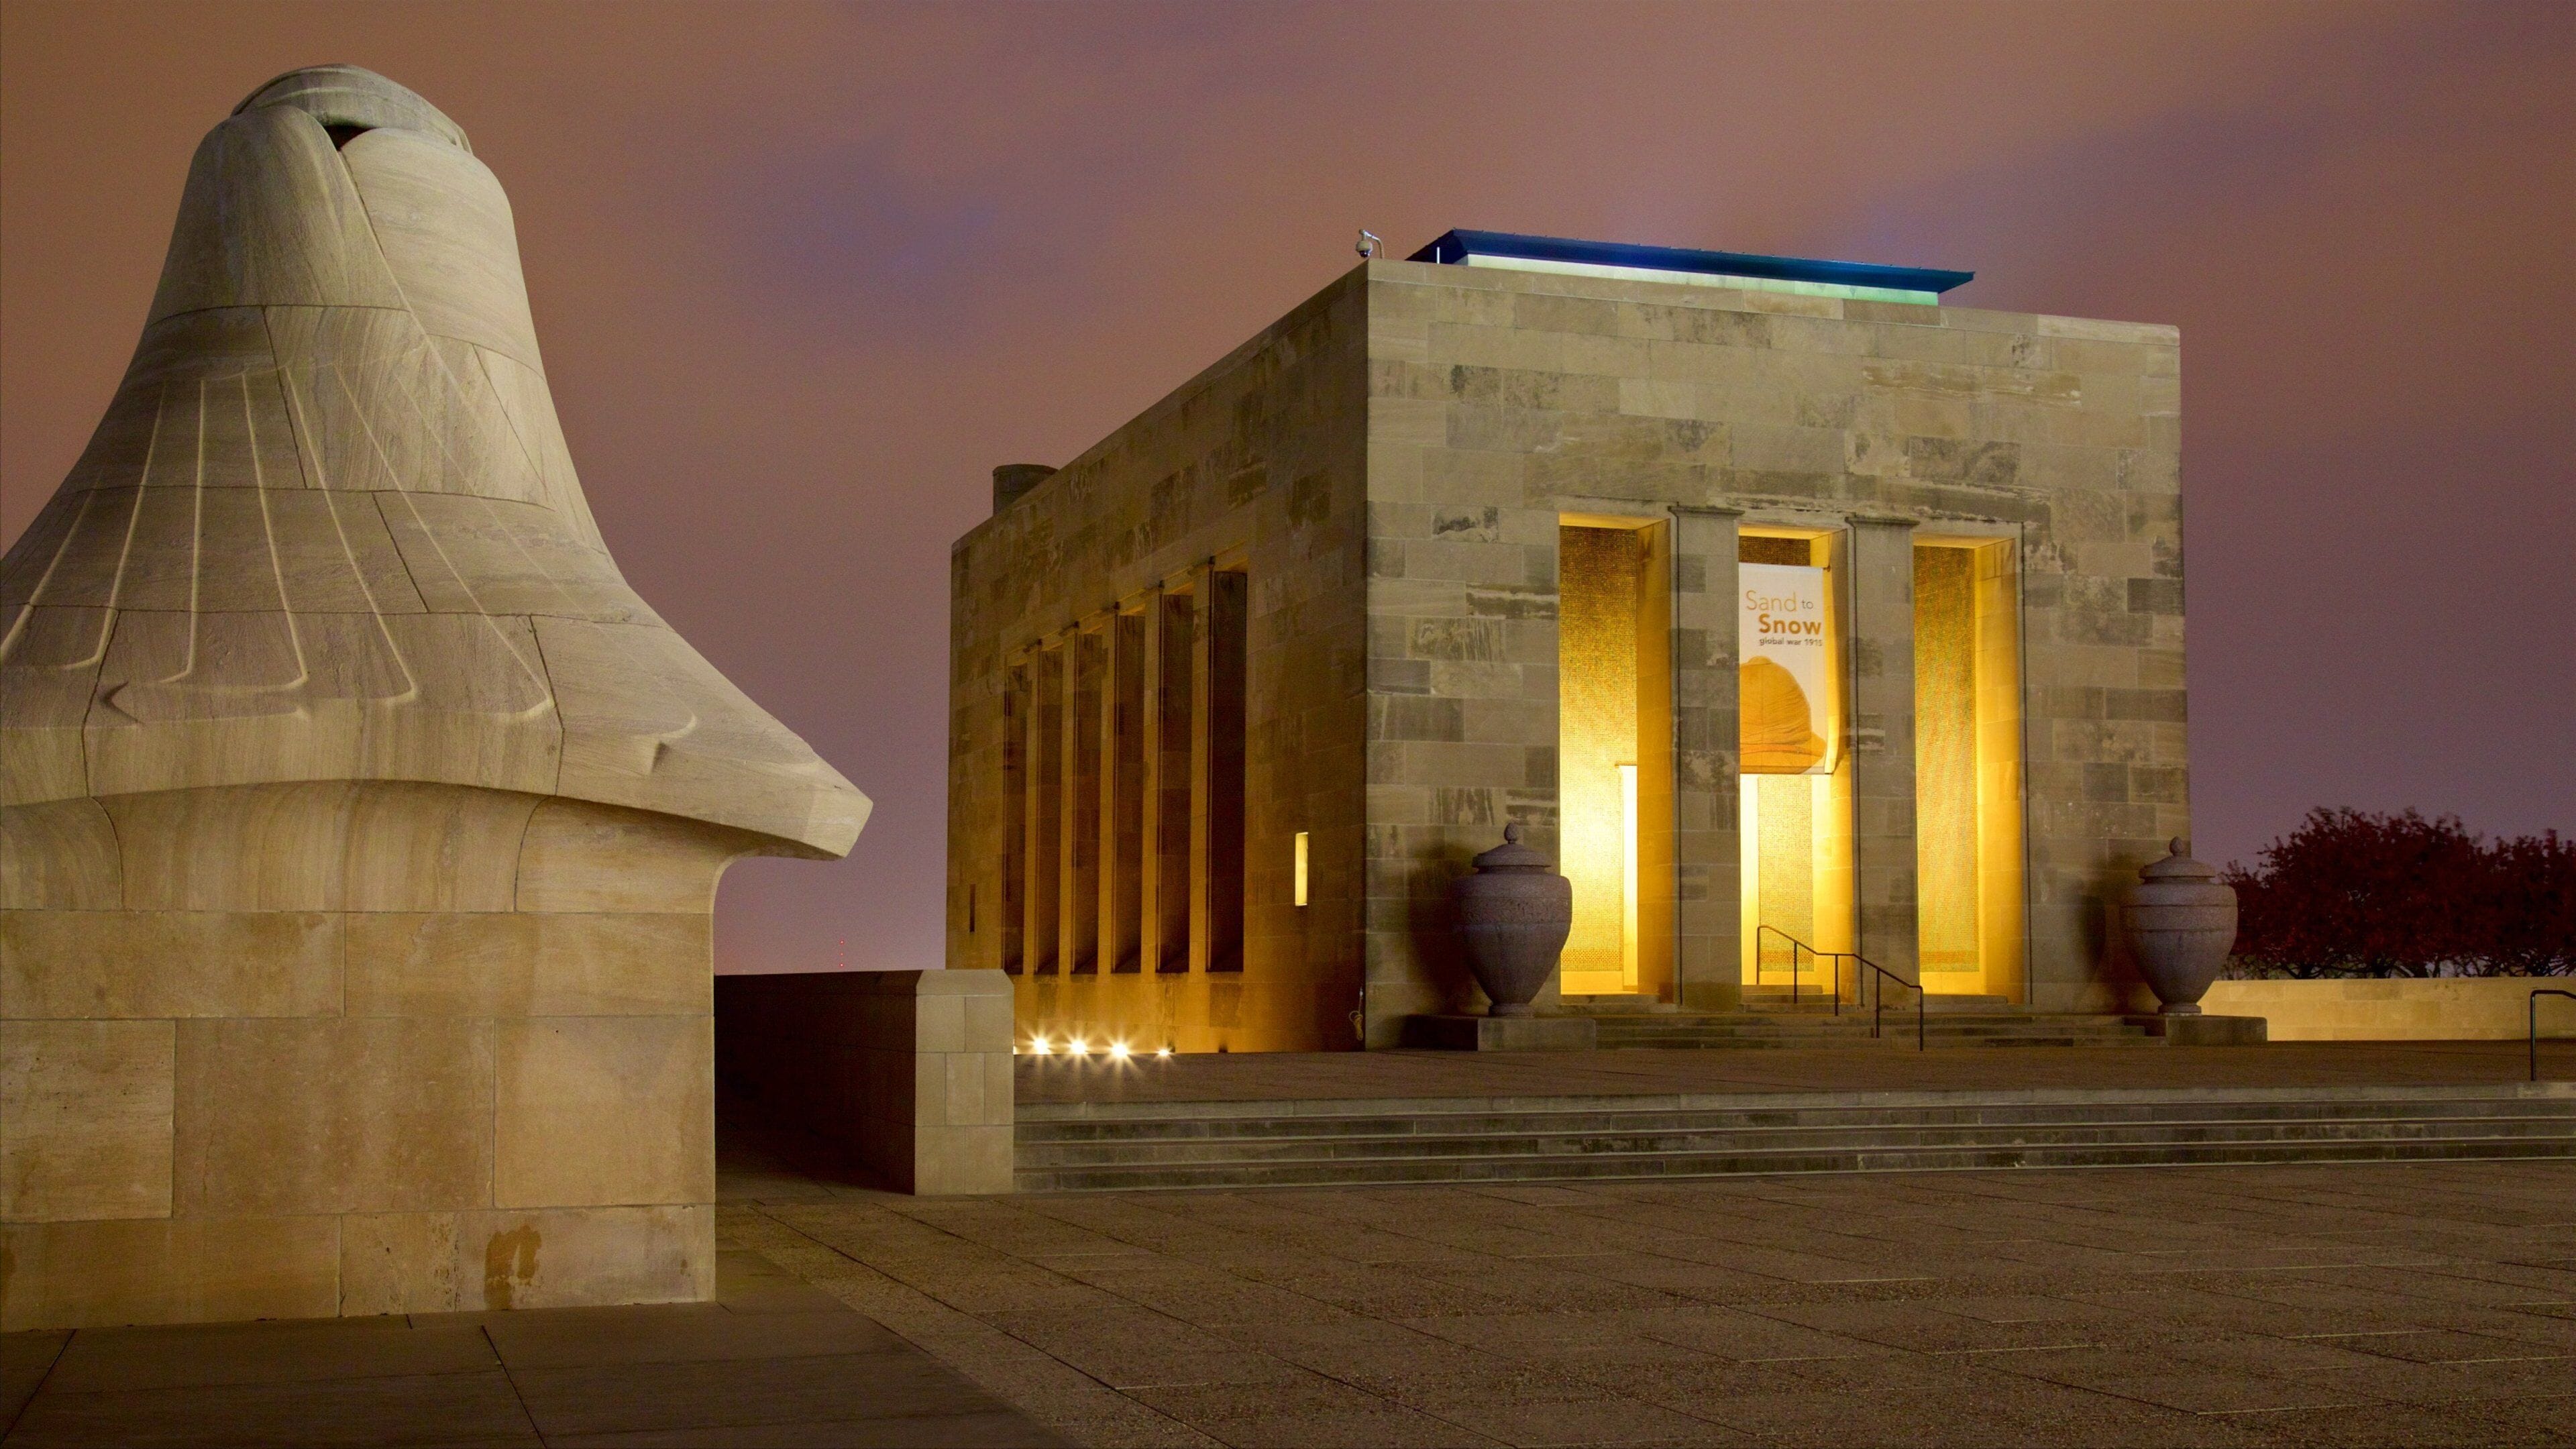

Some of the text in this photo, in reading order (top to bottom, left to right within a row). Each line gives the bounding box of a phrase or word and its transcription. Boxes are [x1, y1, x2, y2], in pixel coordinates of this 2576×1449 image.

[1746, 590, 1814, 612] Sand to
[1758, 613, 1821, 635] Snow
[1759, 637, 1784, 646] global
